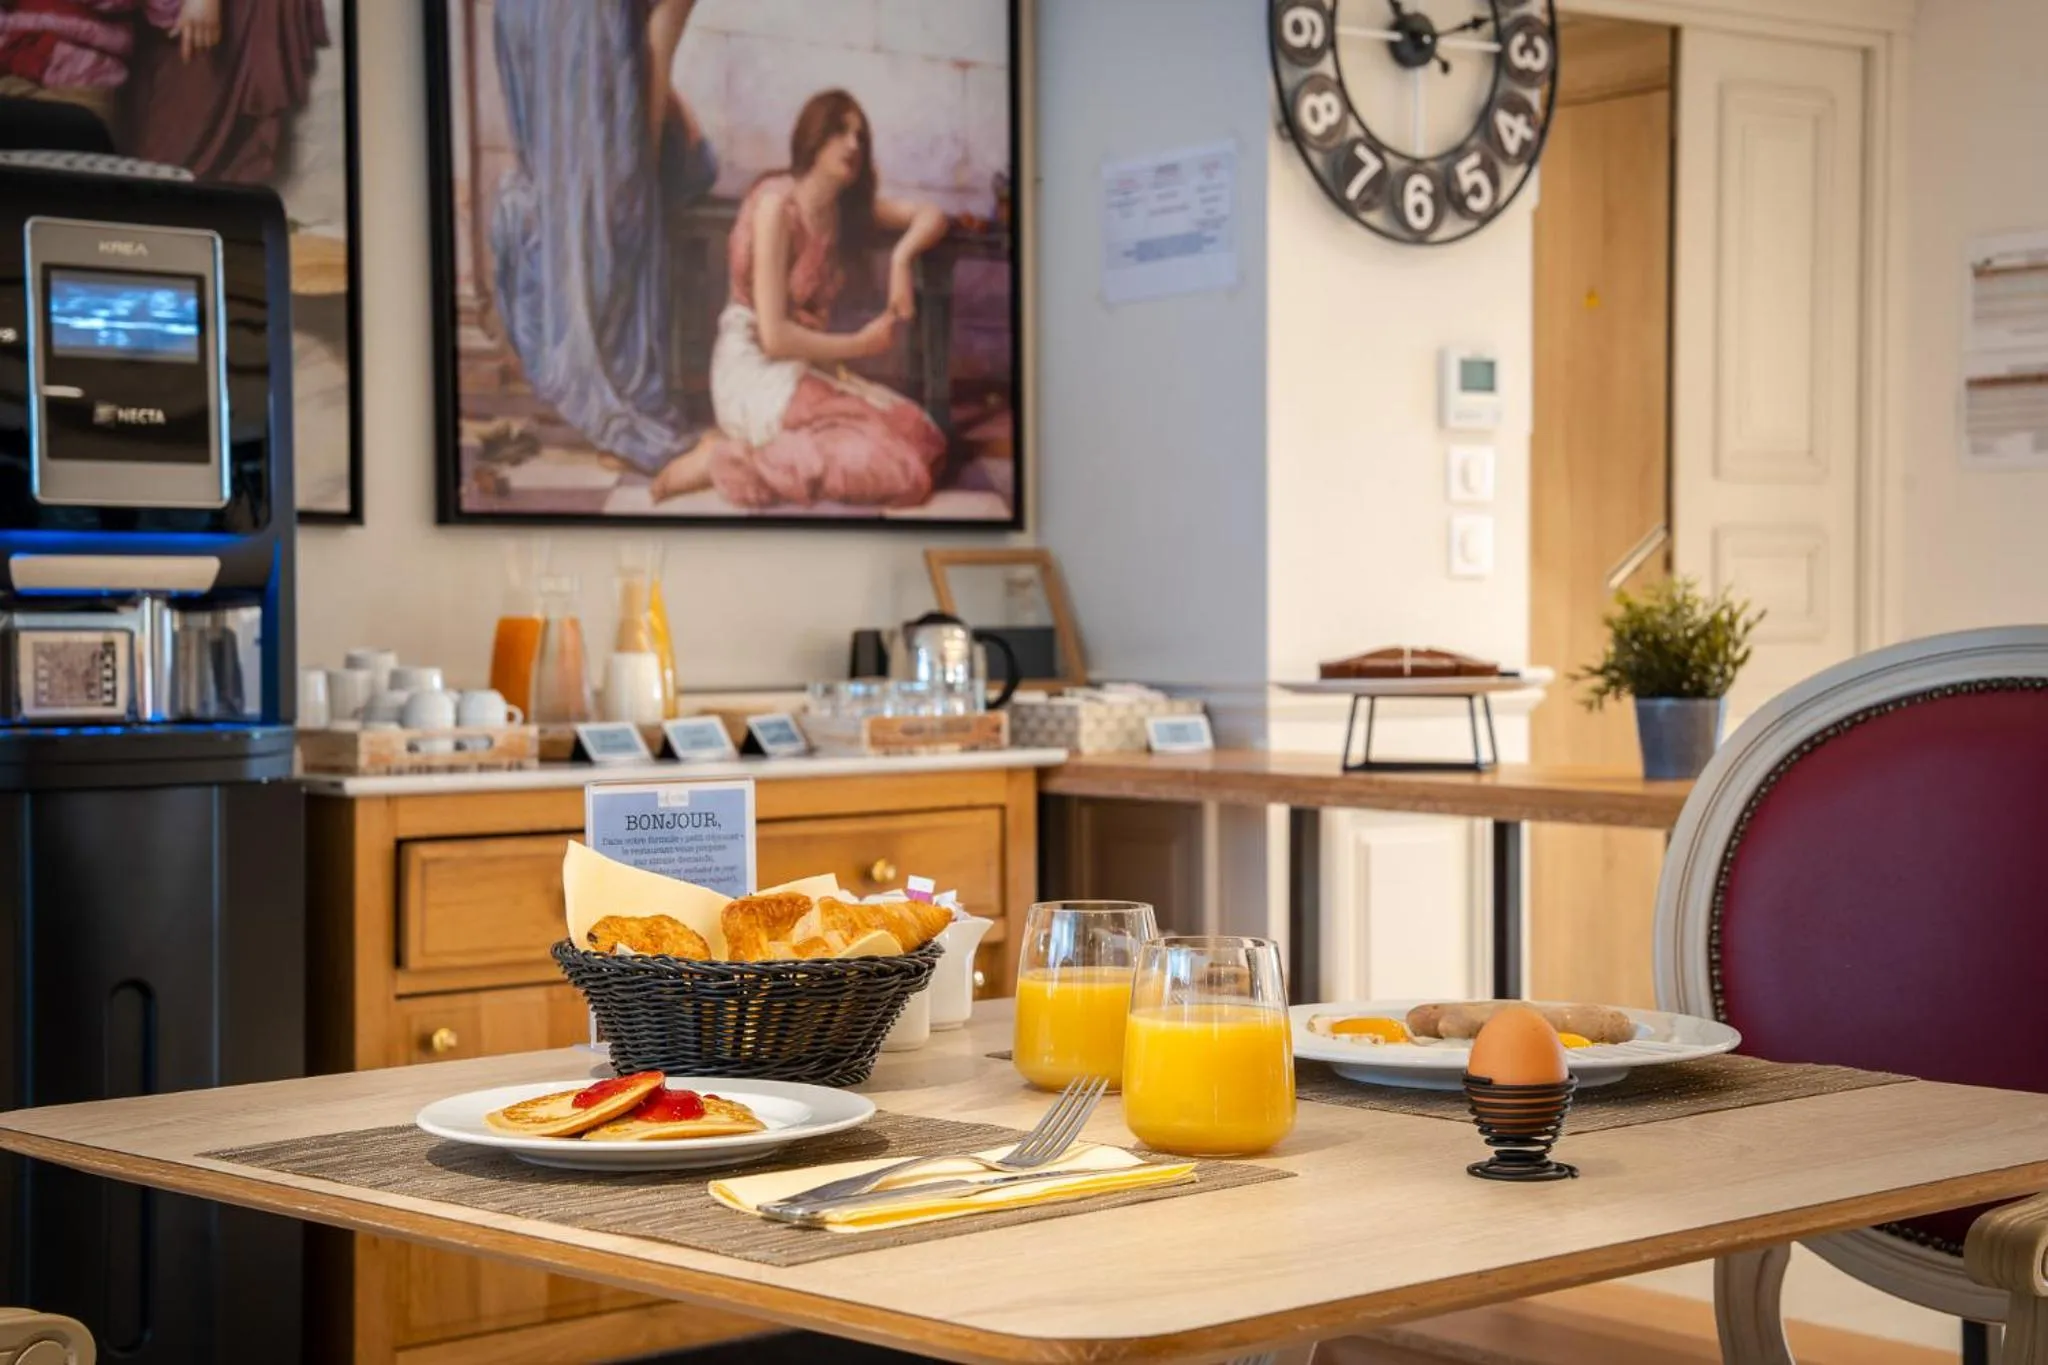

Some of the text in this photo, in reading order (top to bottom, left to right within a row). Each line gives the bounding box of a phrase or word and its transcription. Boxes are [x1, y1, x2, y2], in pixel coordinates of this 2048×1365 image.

[1283, 7, 1325, 49] 9
[1509, 32, 1550, 71] 3
[1301, 92, 1342, 135] 8
[1495, 108, 1536, 155] 4
[1346, 143, 1383, 201] 7
[1455, 152, 1494, 212] 5
[1403, 173, 1435, 231] 6
[117, 407, 166, 425] NECTA
[625, 812, 722, 831] BONJOUR,
